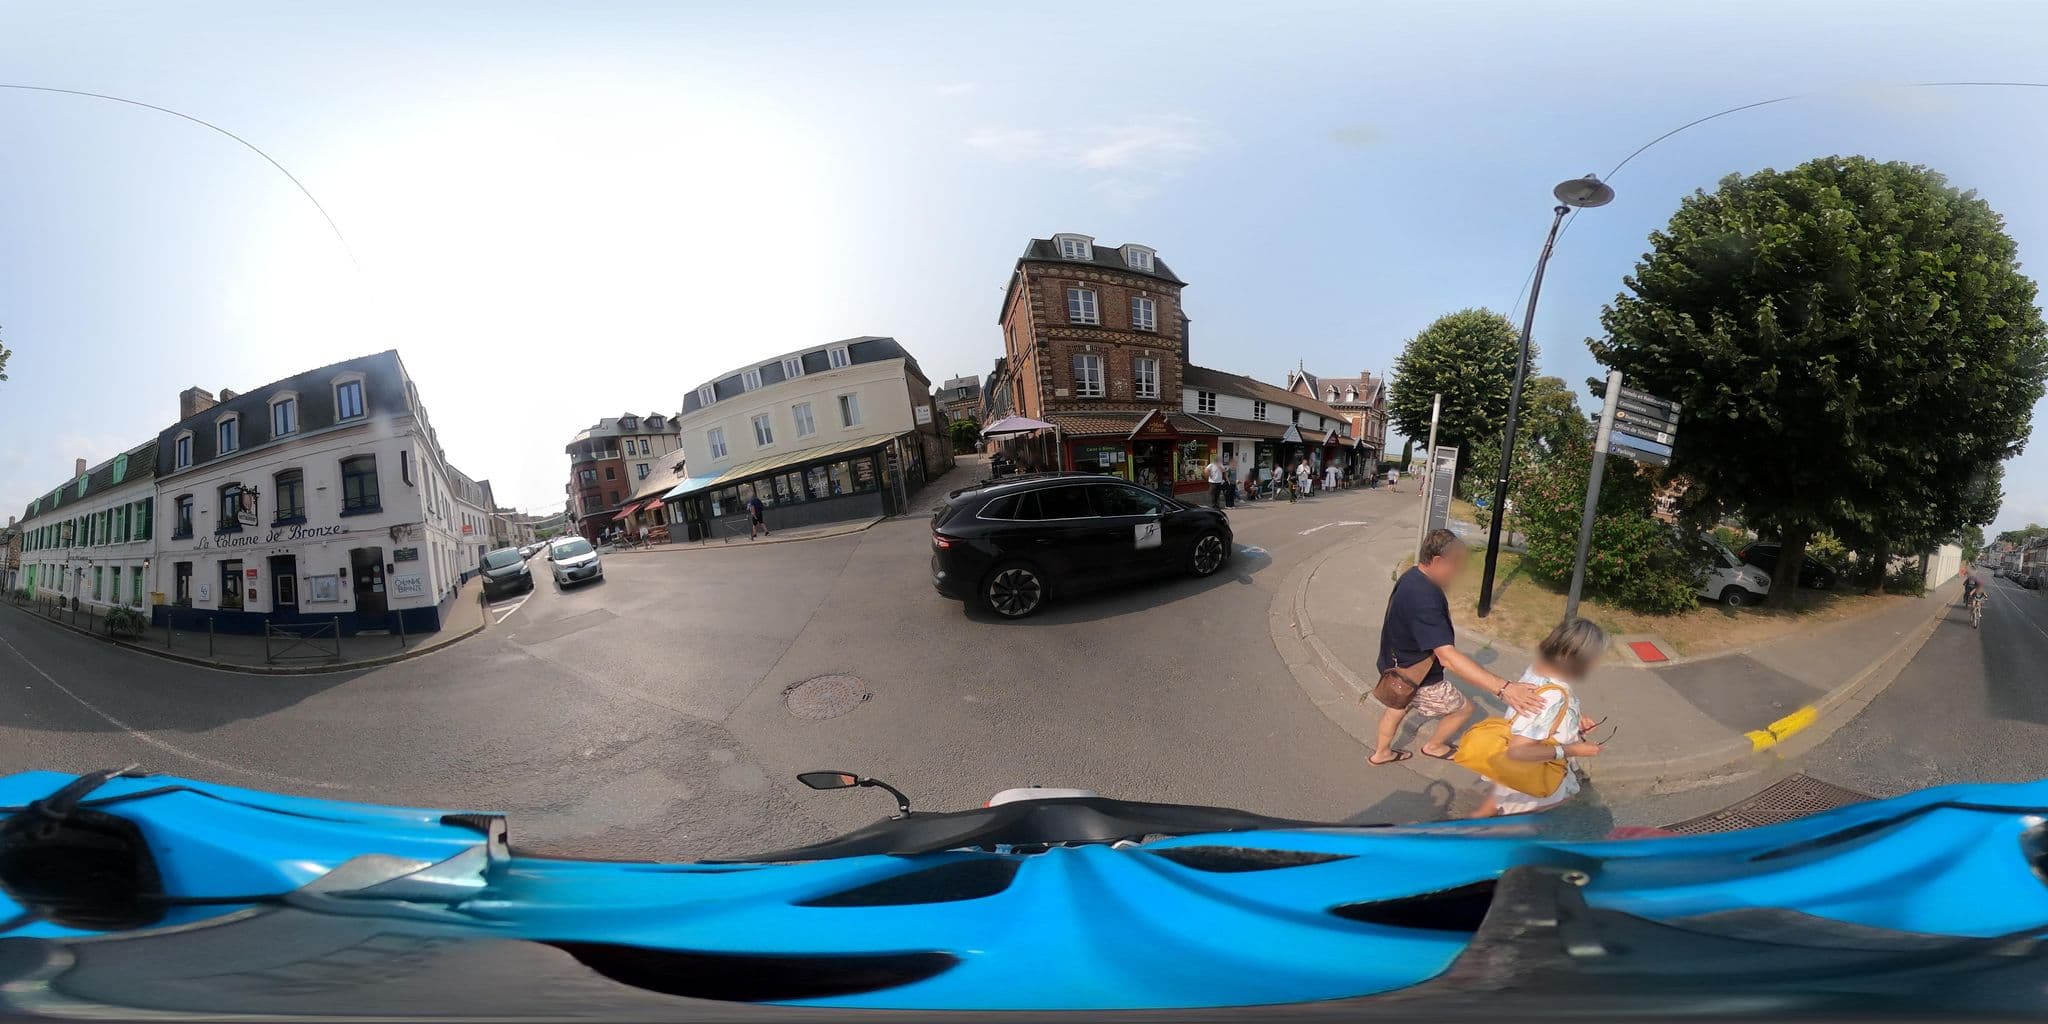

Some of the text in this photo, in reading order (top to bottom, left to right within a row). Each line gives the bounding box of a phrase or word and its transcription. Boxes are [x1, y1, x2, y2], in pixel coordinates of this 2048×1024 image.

[193, 524, 341, 550] La Colonne de Bronze
